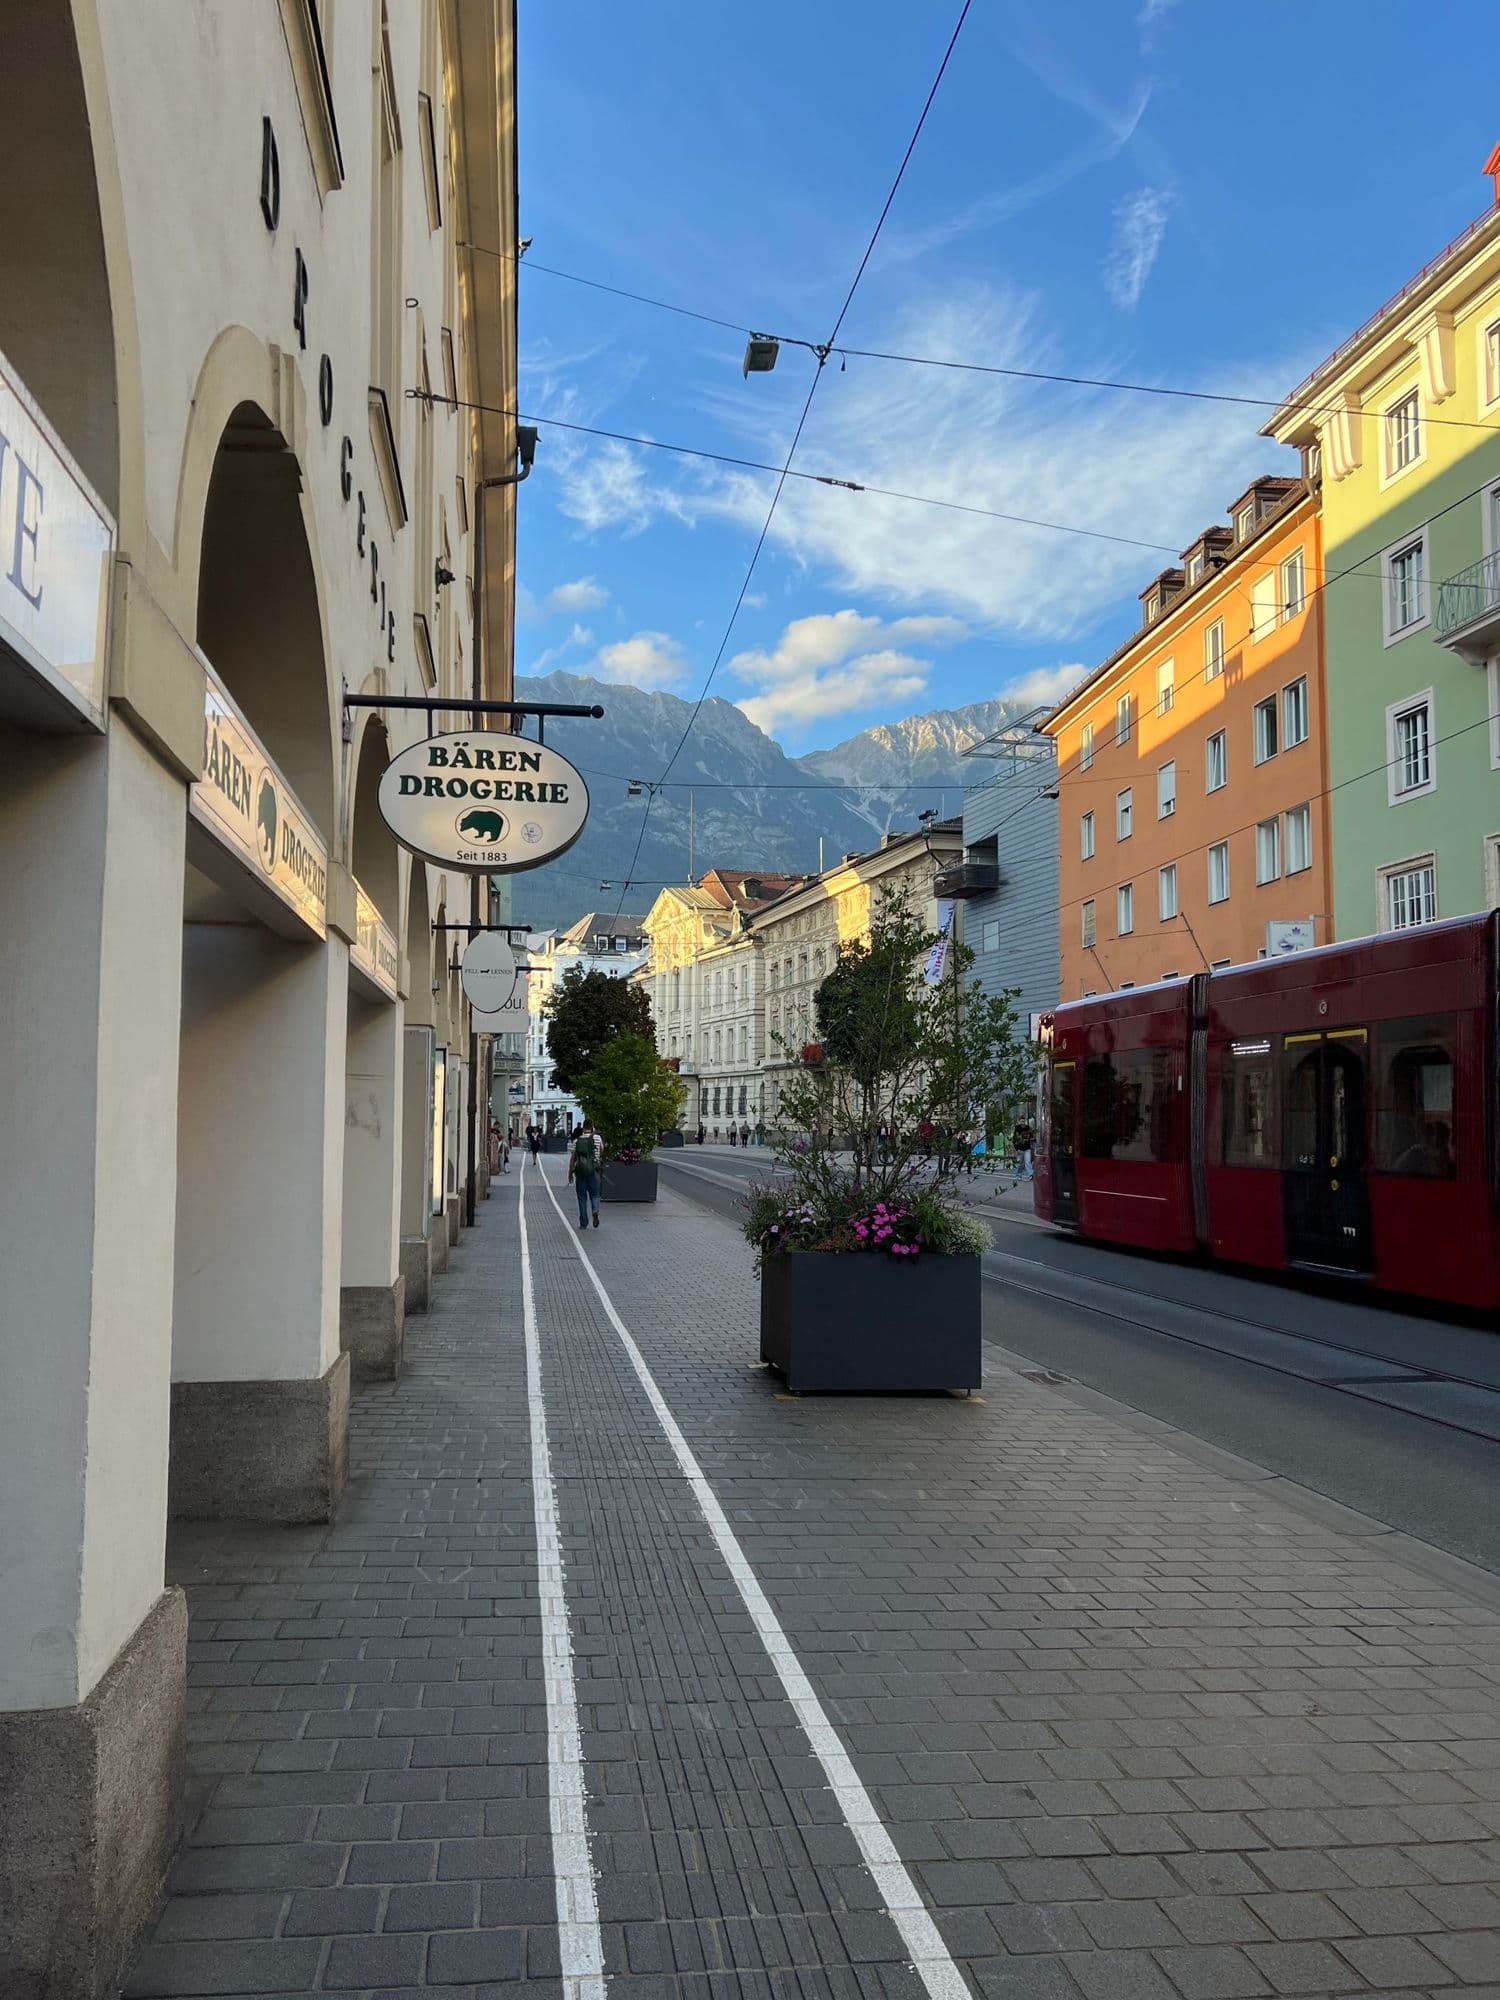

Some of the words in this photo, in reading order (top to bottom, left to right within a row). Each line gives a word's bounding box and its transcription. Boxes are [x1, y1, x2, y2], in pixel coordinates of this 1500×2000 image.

[260, 116, 395, 663] DROGERIE
[428, 741, 542, 772] BÄREN
[398, 774, 569, 804] DROGERIE
[281, 819, 326, 904] DROGERIE
[456, 850, 478, 862] Seit
[481, 851, 508, 862] 1883
